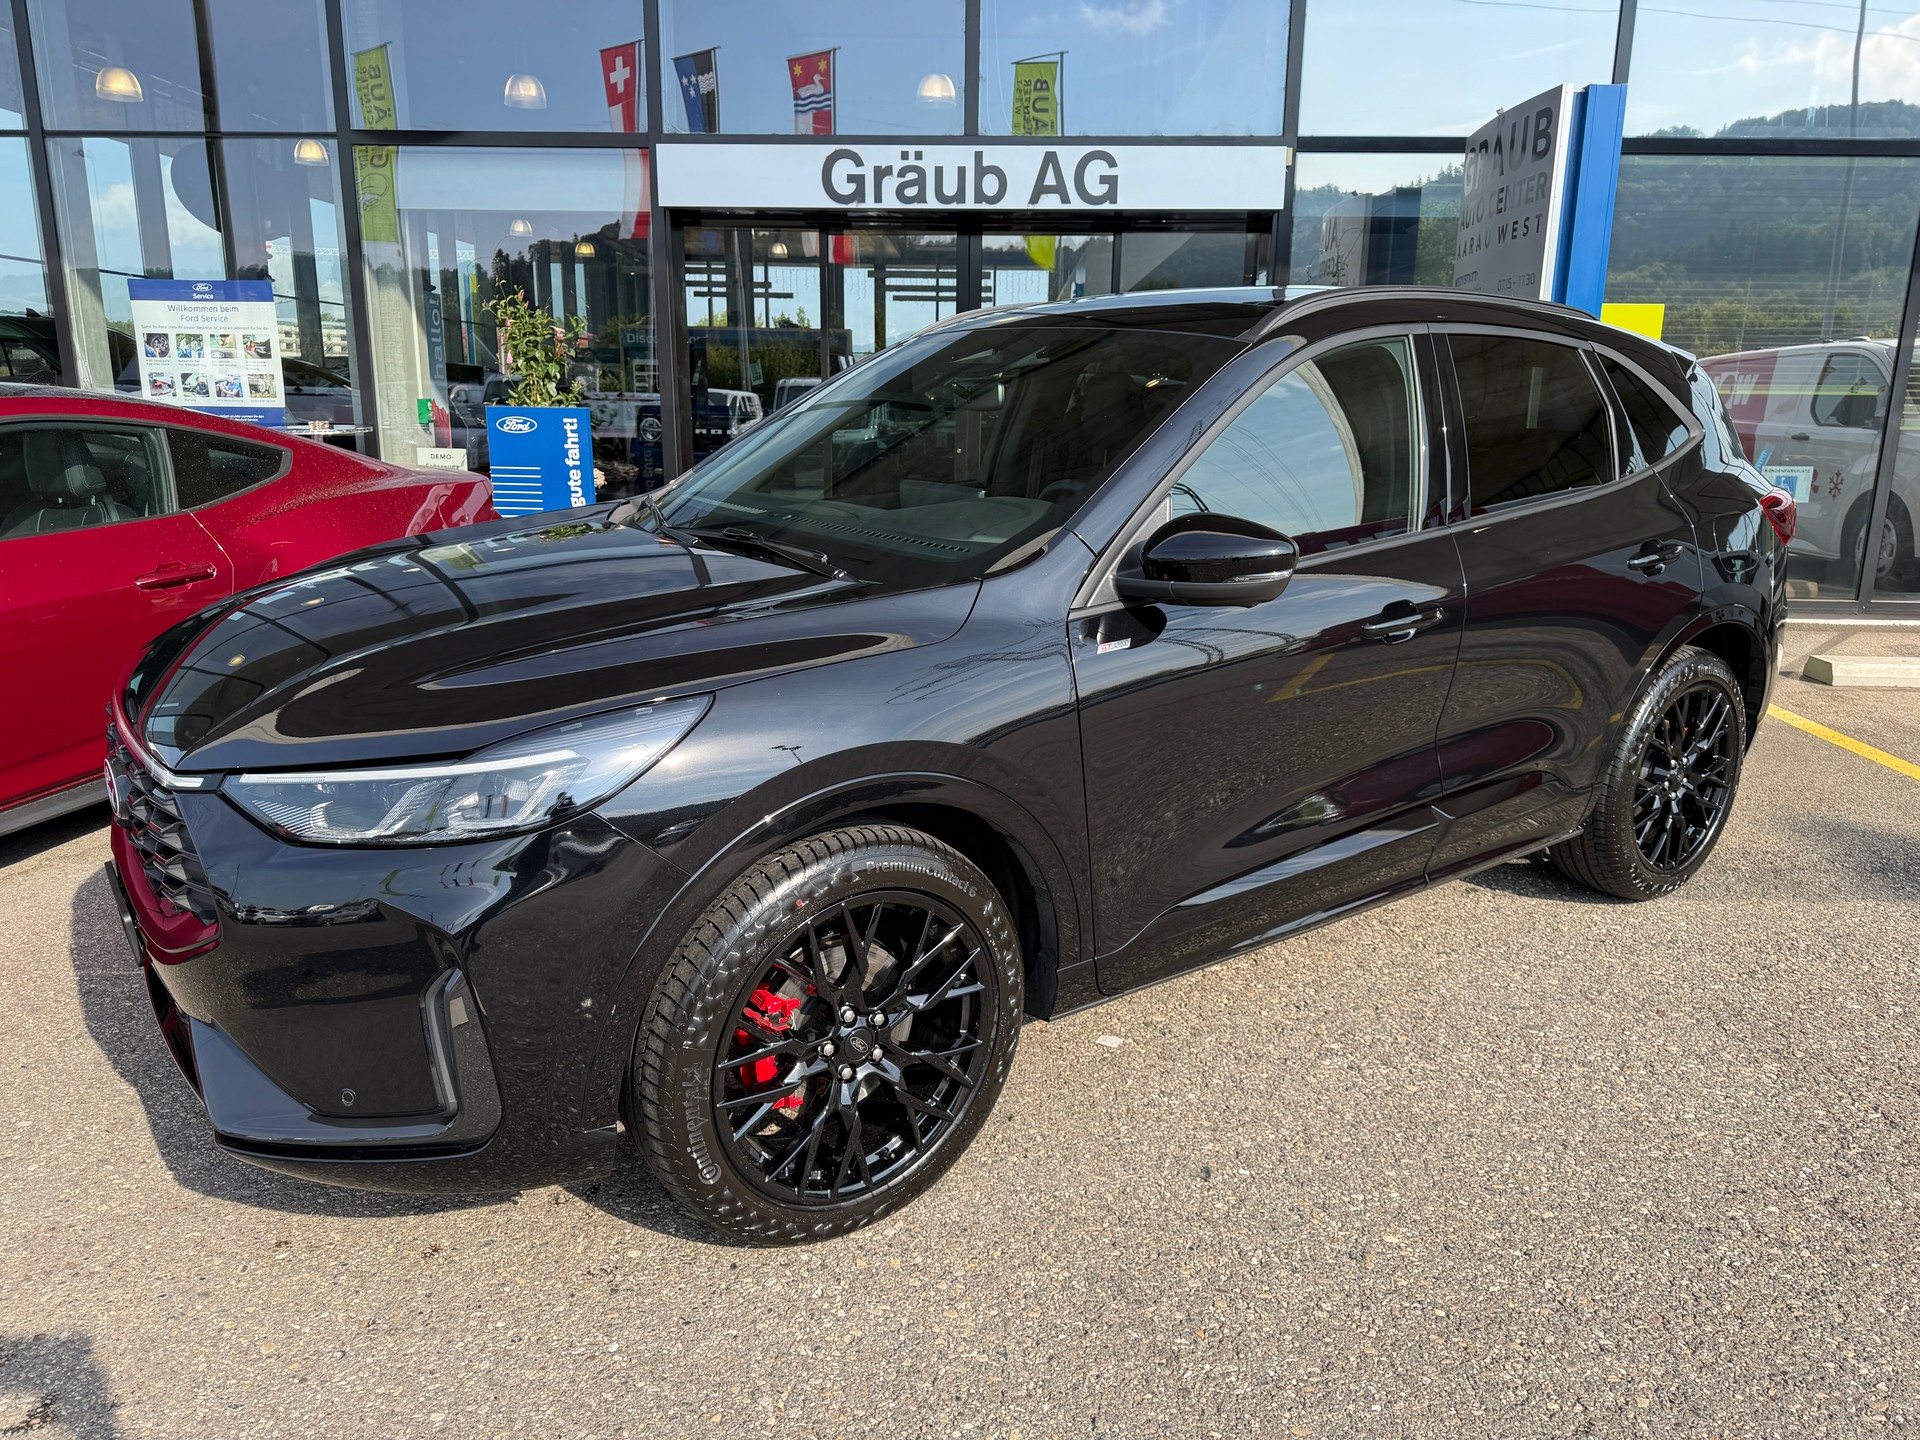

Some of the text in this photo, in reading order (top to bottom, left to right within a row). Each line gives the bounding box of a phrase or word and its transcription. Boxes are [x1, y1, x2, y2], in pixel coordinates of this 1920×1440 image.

[821, 148, 1120, 205] Gräub AG
[1497, 213, 1544, 245] WEST
[192, 292, 214, 300] Service
[167, 304, 240, 313] Willkommen beim
[180, 314, 229, 323] Ford Service
[429, 298, 446, 380] hallo!
[502, 417, 532, 432] Ford
[562, 417, 587, 508] gute fahrt!
[968, 885, 978, 898] 6
